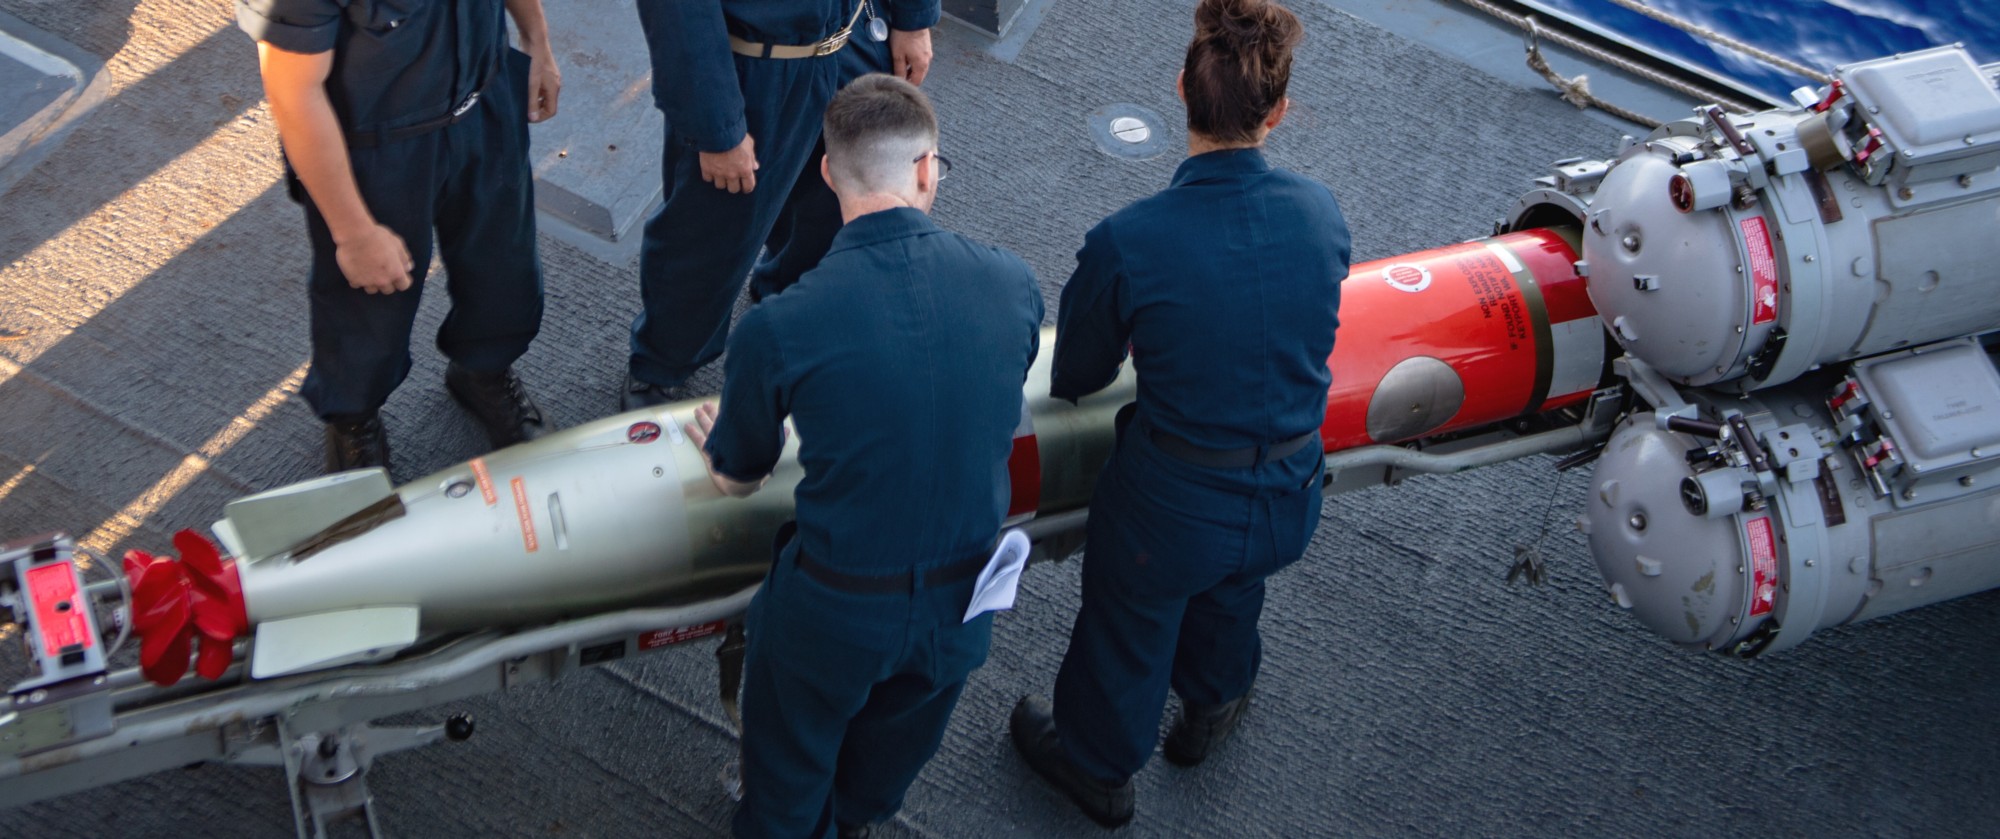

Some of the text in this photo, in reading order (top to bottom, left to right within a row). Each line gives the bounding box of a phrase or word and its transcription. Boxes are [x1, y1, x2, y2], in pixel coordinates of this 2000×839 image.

[1475, 271, 1498, 307] REWARD
[1484, 271, 1506, 301] NOTIFY
[1478, 297, 1492, 319] NON
[1501, 302, 1517, 338] FOUND
[1508, 294, 1526, 339] KEYPORT
